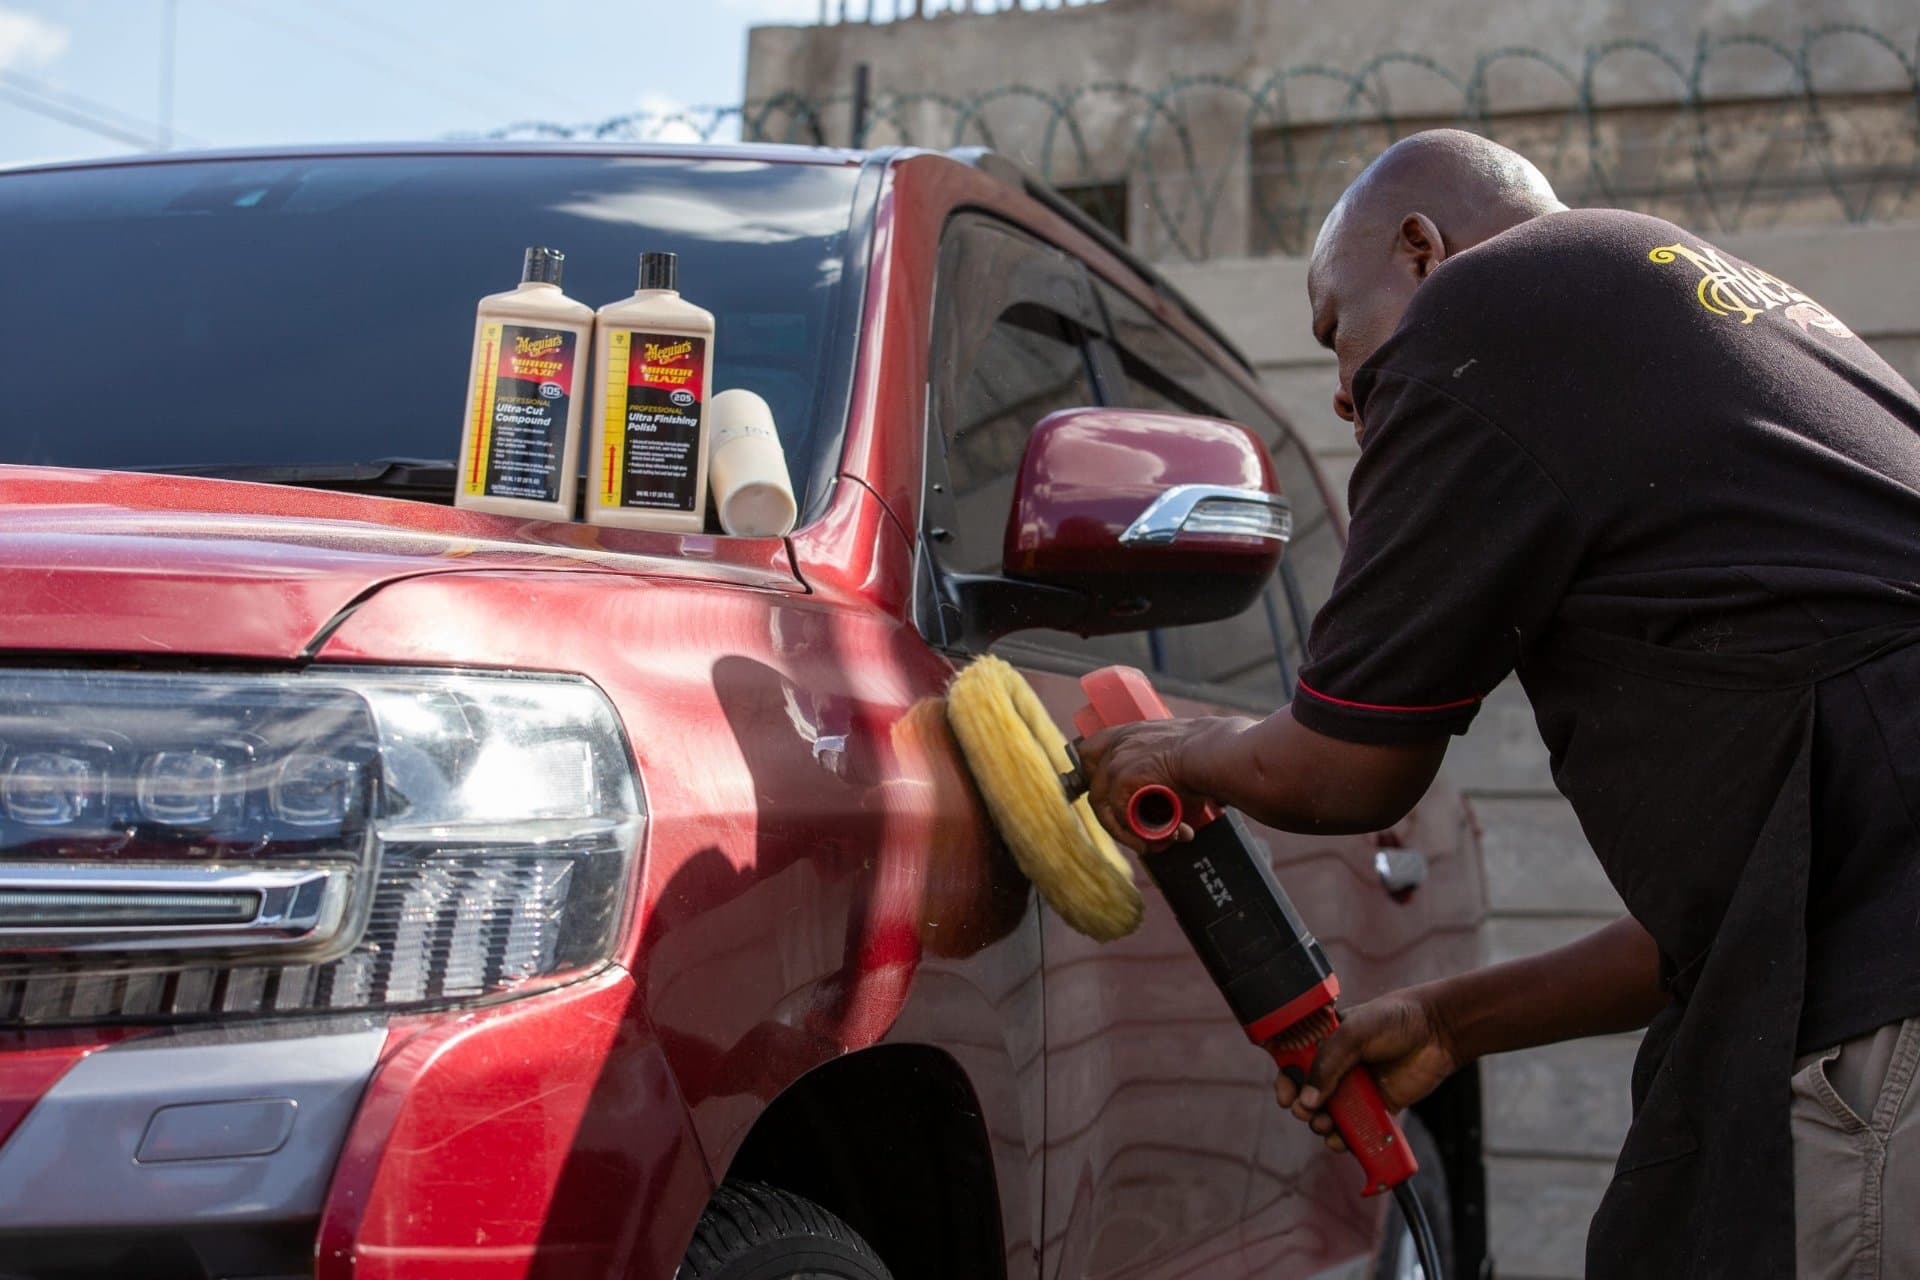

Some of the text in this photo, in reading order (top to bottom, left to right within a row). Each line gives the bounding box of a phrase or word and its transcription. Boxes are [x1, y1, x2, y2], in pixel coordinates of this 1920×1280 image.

[644, 341, 692, 363] Meguiar's
[514, 367, 557, 377] GLAZE
[641, 366, 694, 377] MIRROR
[643, 375, 687, 384] GLAZE
[543, 386, 560, 396] 105
[674, 394, 692, 402] 205
[496, 403, 545, 416] Ultra-Cut
[629, 405, 683, 415] PROFESSIONAL
[495, 413, 552, 426] Compound
[628, 412, 698, 427] Ultra Finishing
[627, 422, 657, 432] Polish
[1193, 856, 1233, 908] FLEX
